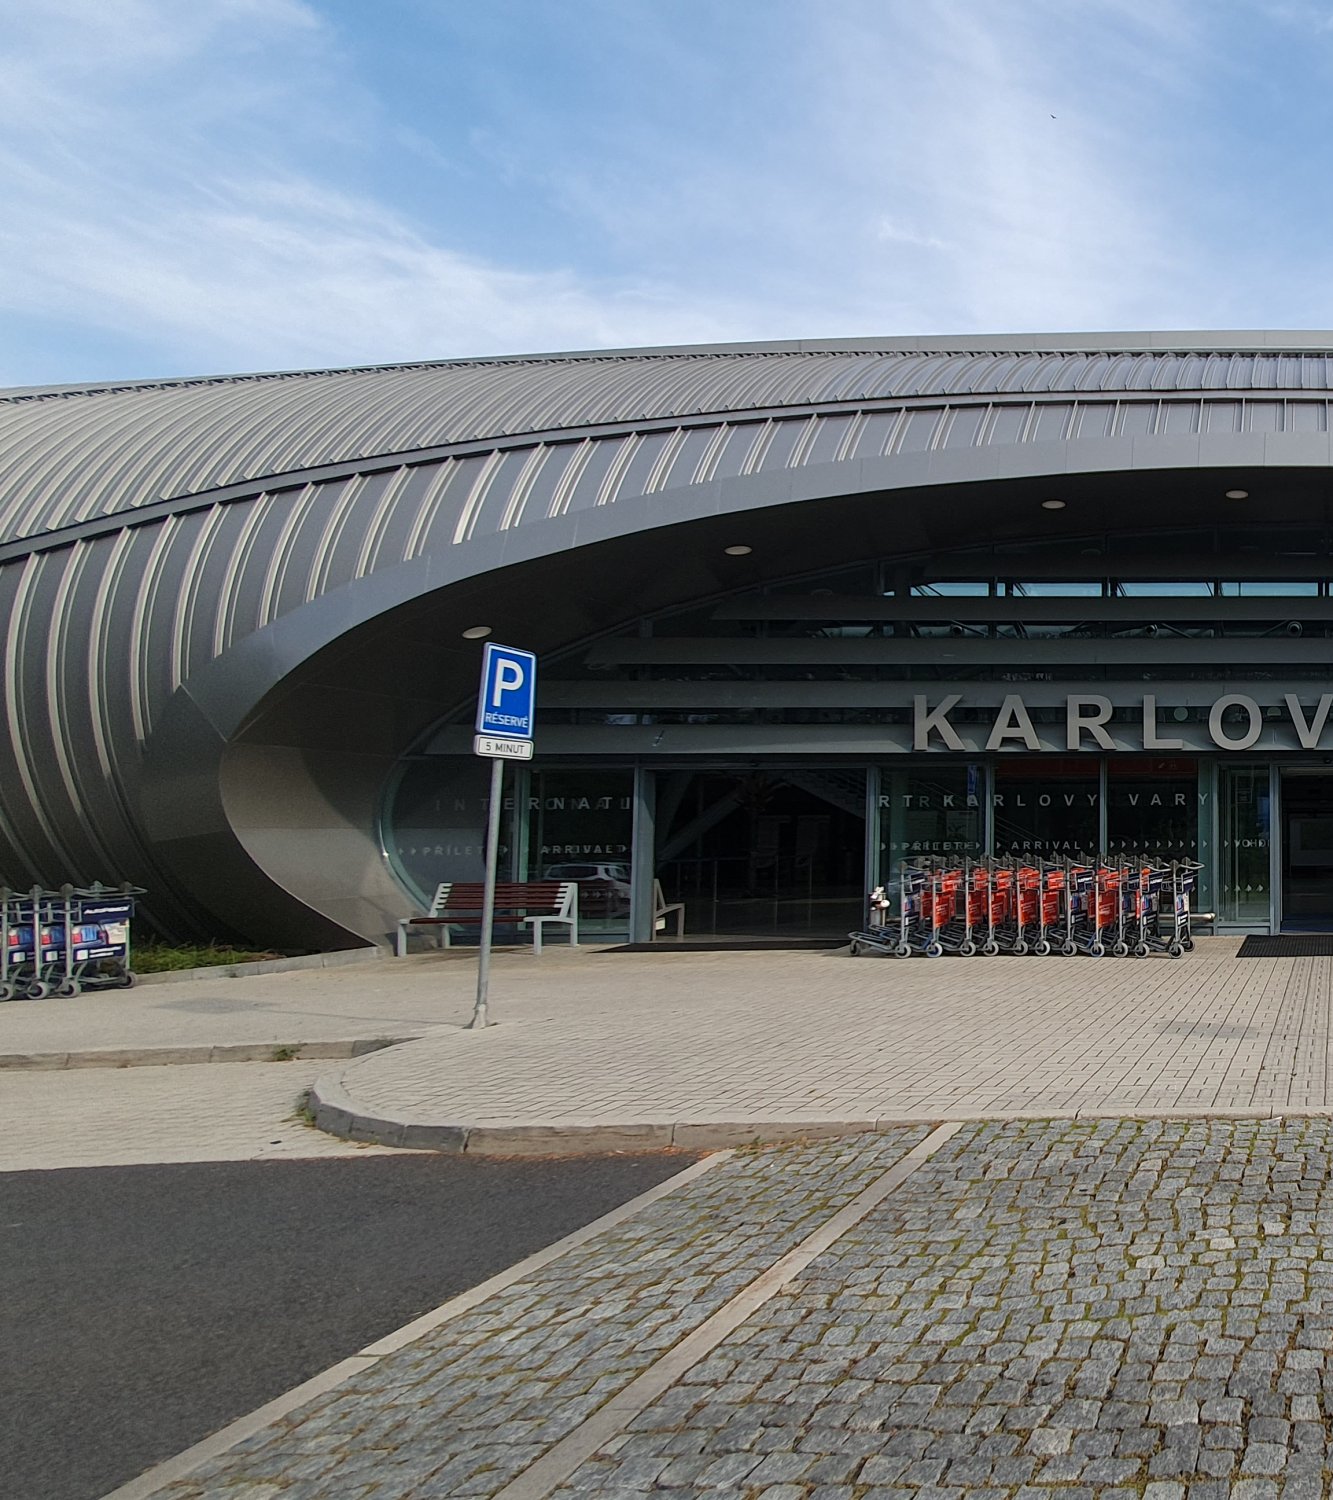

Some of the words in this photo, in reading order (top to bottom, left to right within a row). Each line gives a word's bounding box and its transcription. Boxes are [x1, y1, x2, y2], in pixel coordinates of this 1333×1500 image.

[492, 658, 524, 707] P
[485, 711, 529, 728] RÉSERVÉ
[485, 741, 492, 751] 5
[495, 743, 525, 754] MINUT
[1128, 792, 1209, 806] VARY
[1011, 840, 1082, 850] ARRIVAL
